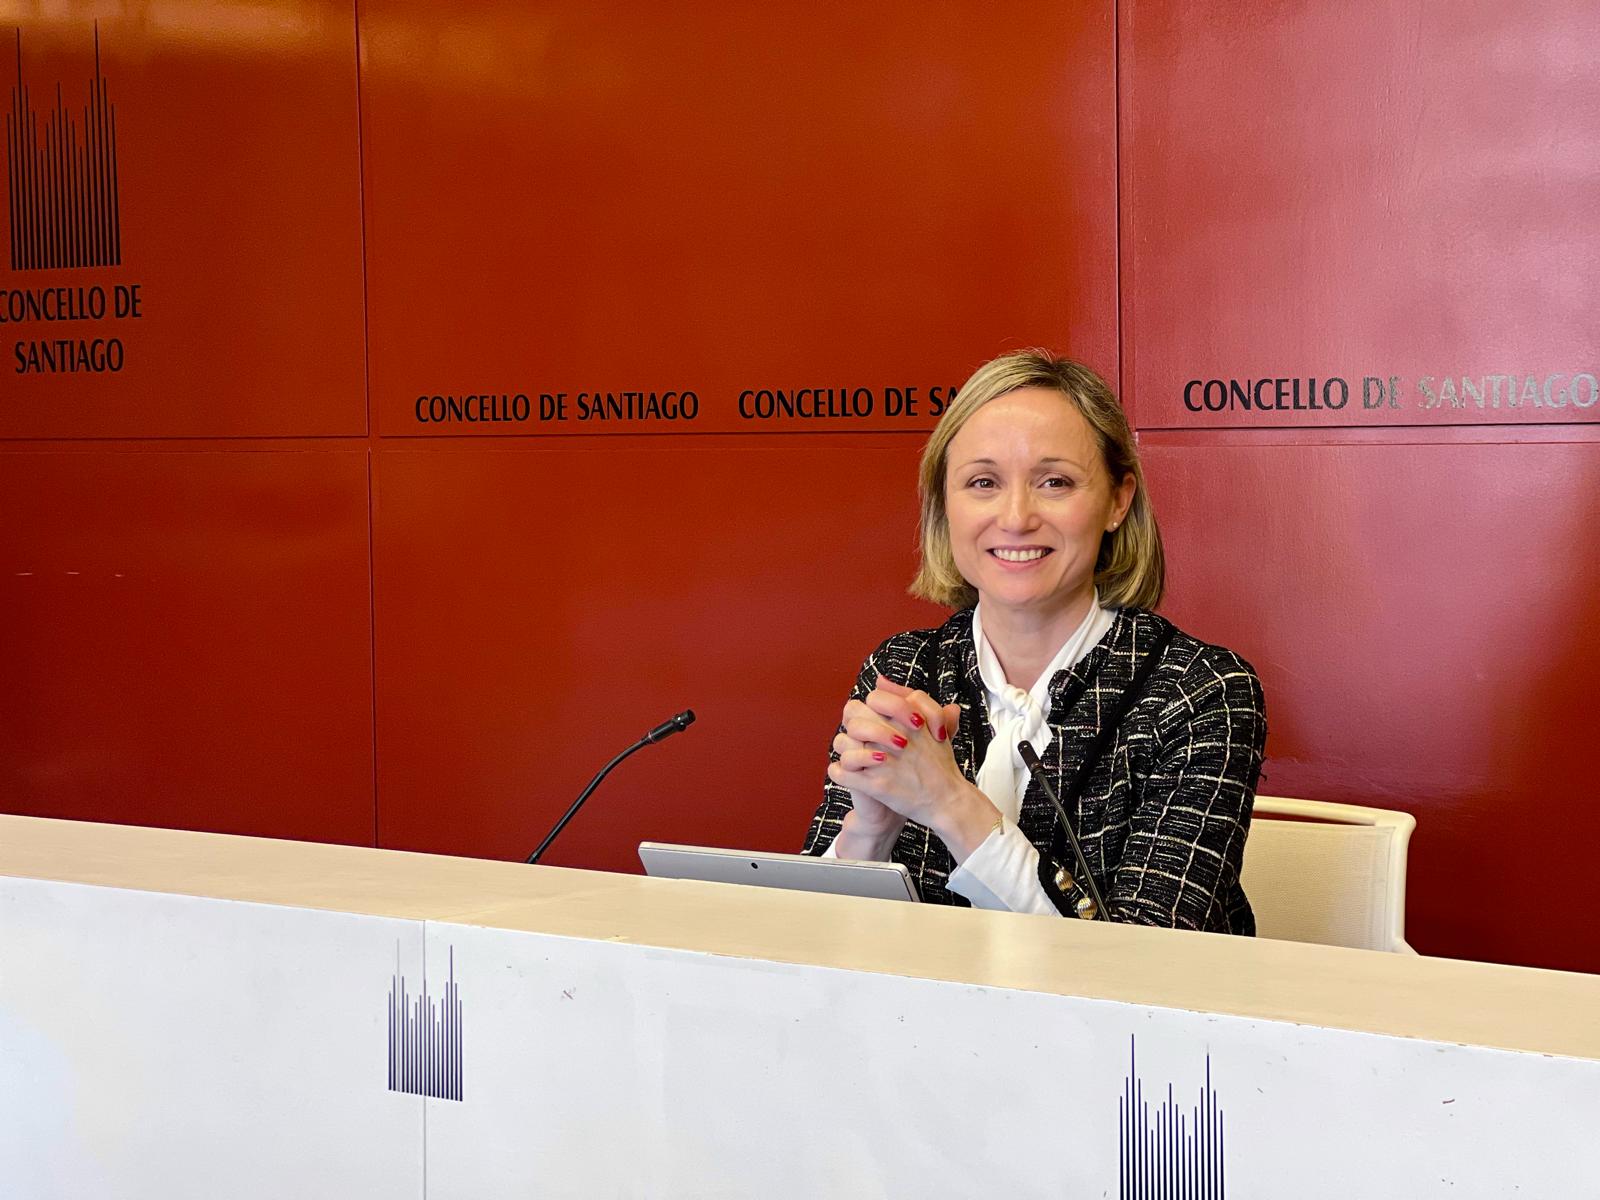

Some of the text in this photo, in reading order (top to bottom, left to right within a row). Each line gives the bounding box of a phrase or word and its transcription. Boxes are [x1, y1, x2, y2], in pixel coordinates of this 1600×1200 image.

[114, 285, 142, 319] DE
[15, 338, 124, 374] SANTIAGO
[415, 391, 700, 423] CONCELLO DE SANTIAGO
[738, 387, 874, 419] CONCELLO
[884, 387, 918, 417] DE
[1183, 373, 1600, 412] CONCELLO DE SANTIAGO
